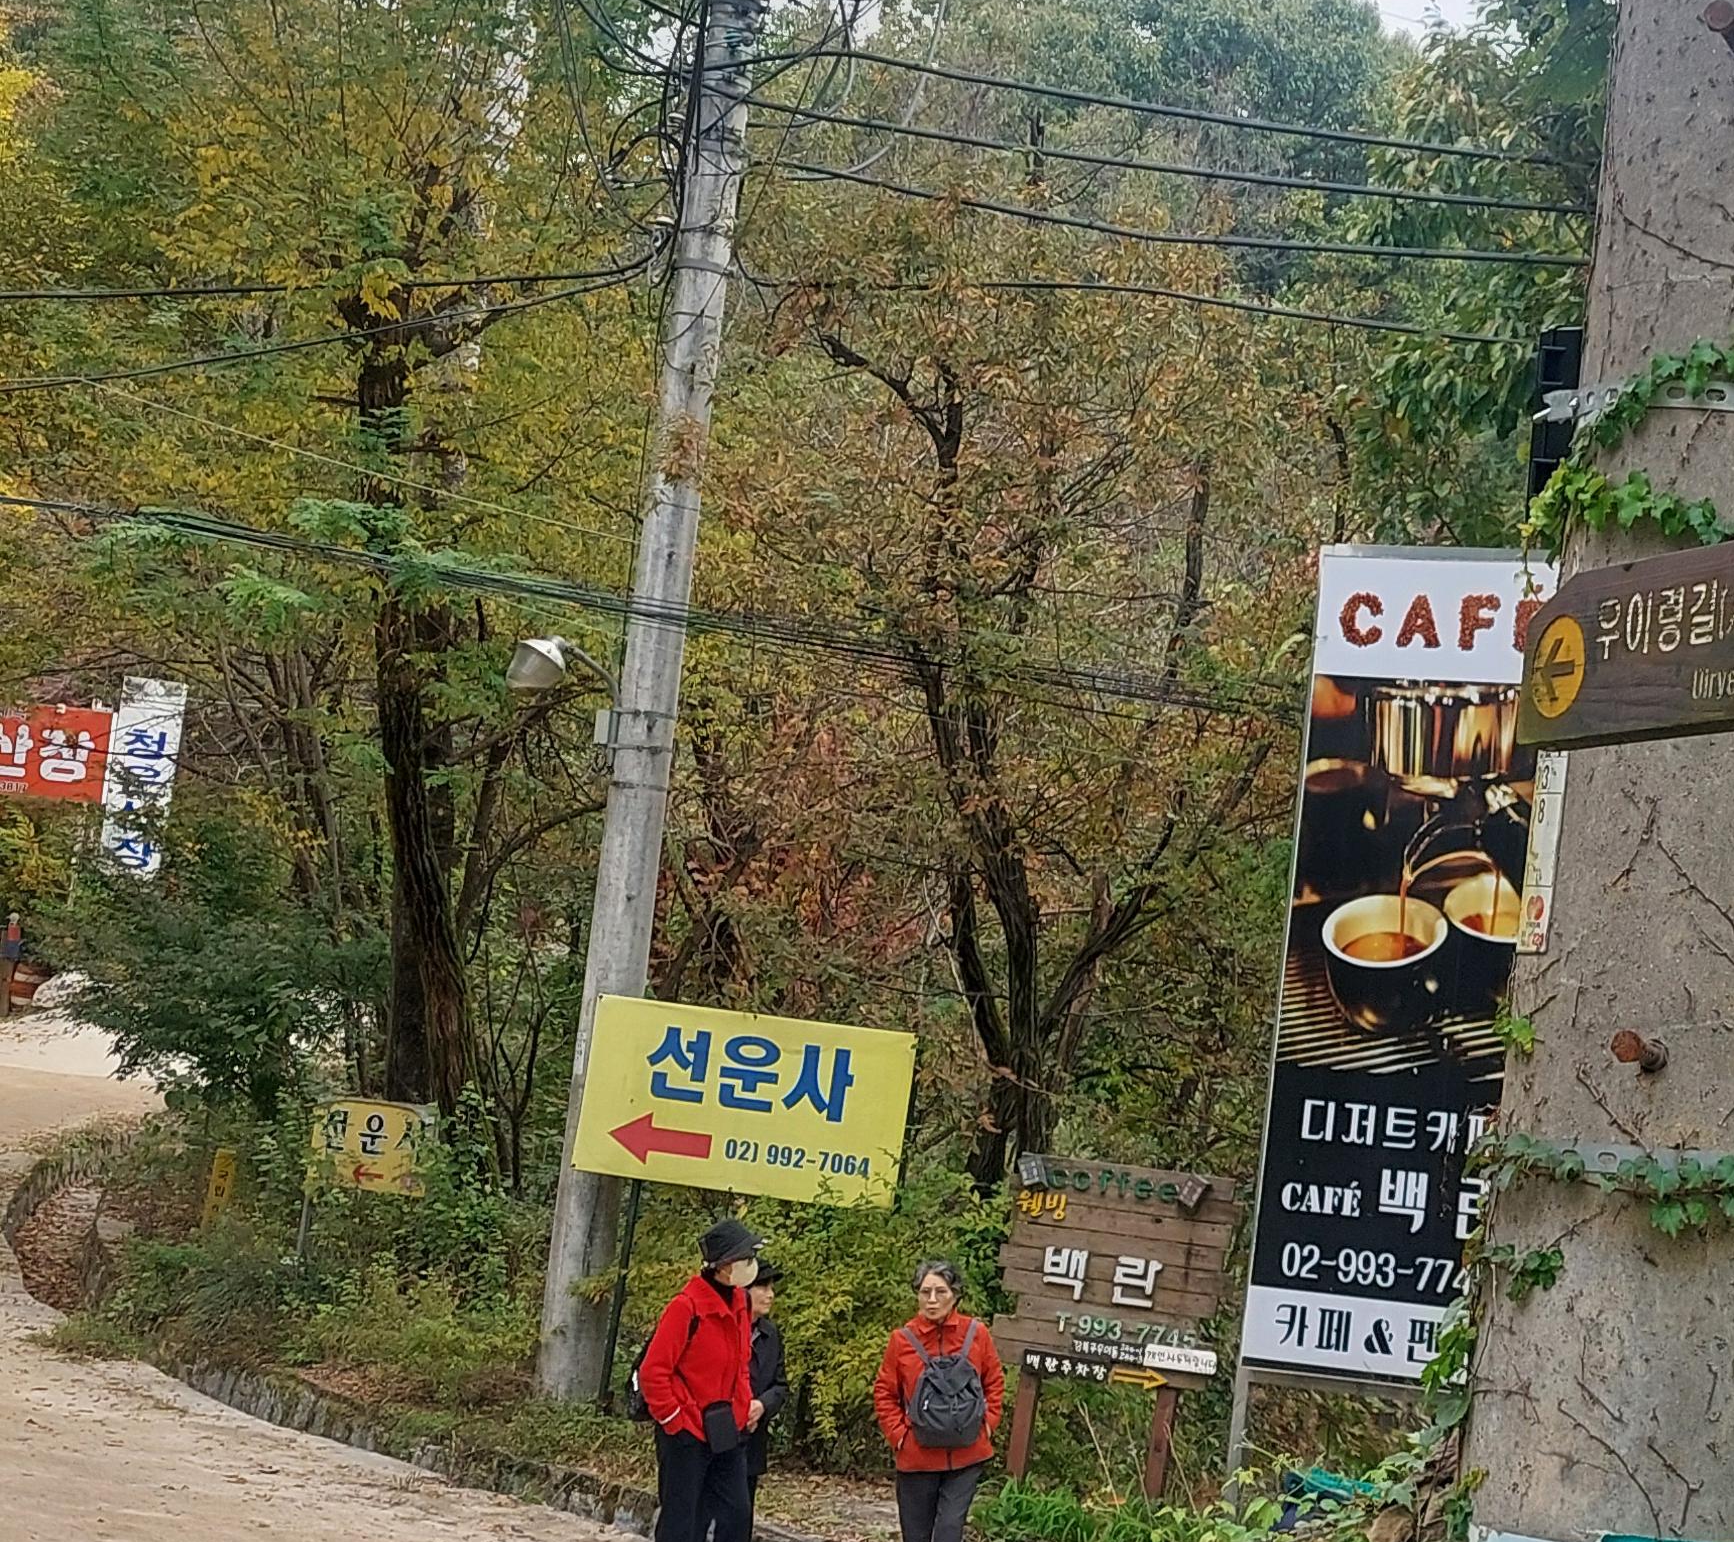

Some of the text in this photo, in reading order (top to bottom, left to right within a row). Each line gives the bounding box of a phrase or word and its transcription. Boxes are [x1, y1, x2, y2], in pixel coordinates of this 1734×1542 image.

[646, 1025, 855, 1123] 선운사
[766, 1143, 871, 1179] 992-7064
[1051, 1168, 1179, 1204] coffee
[1281, 1180, 1362, 1217] CAFÉ
[1281, 1242, 1471, 1296] 02-993-774
[1275, 1303, 1353, 1353] 카페
[1363, 1317, 1394, 1356] &
